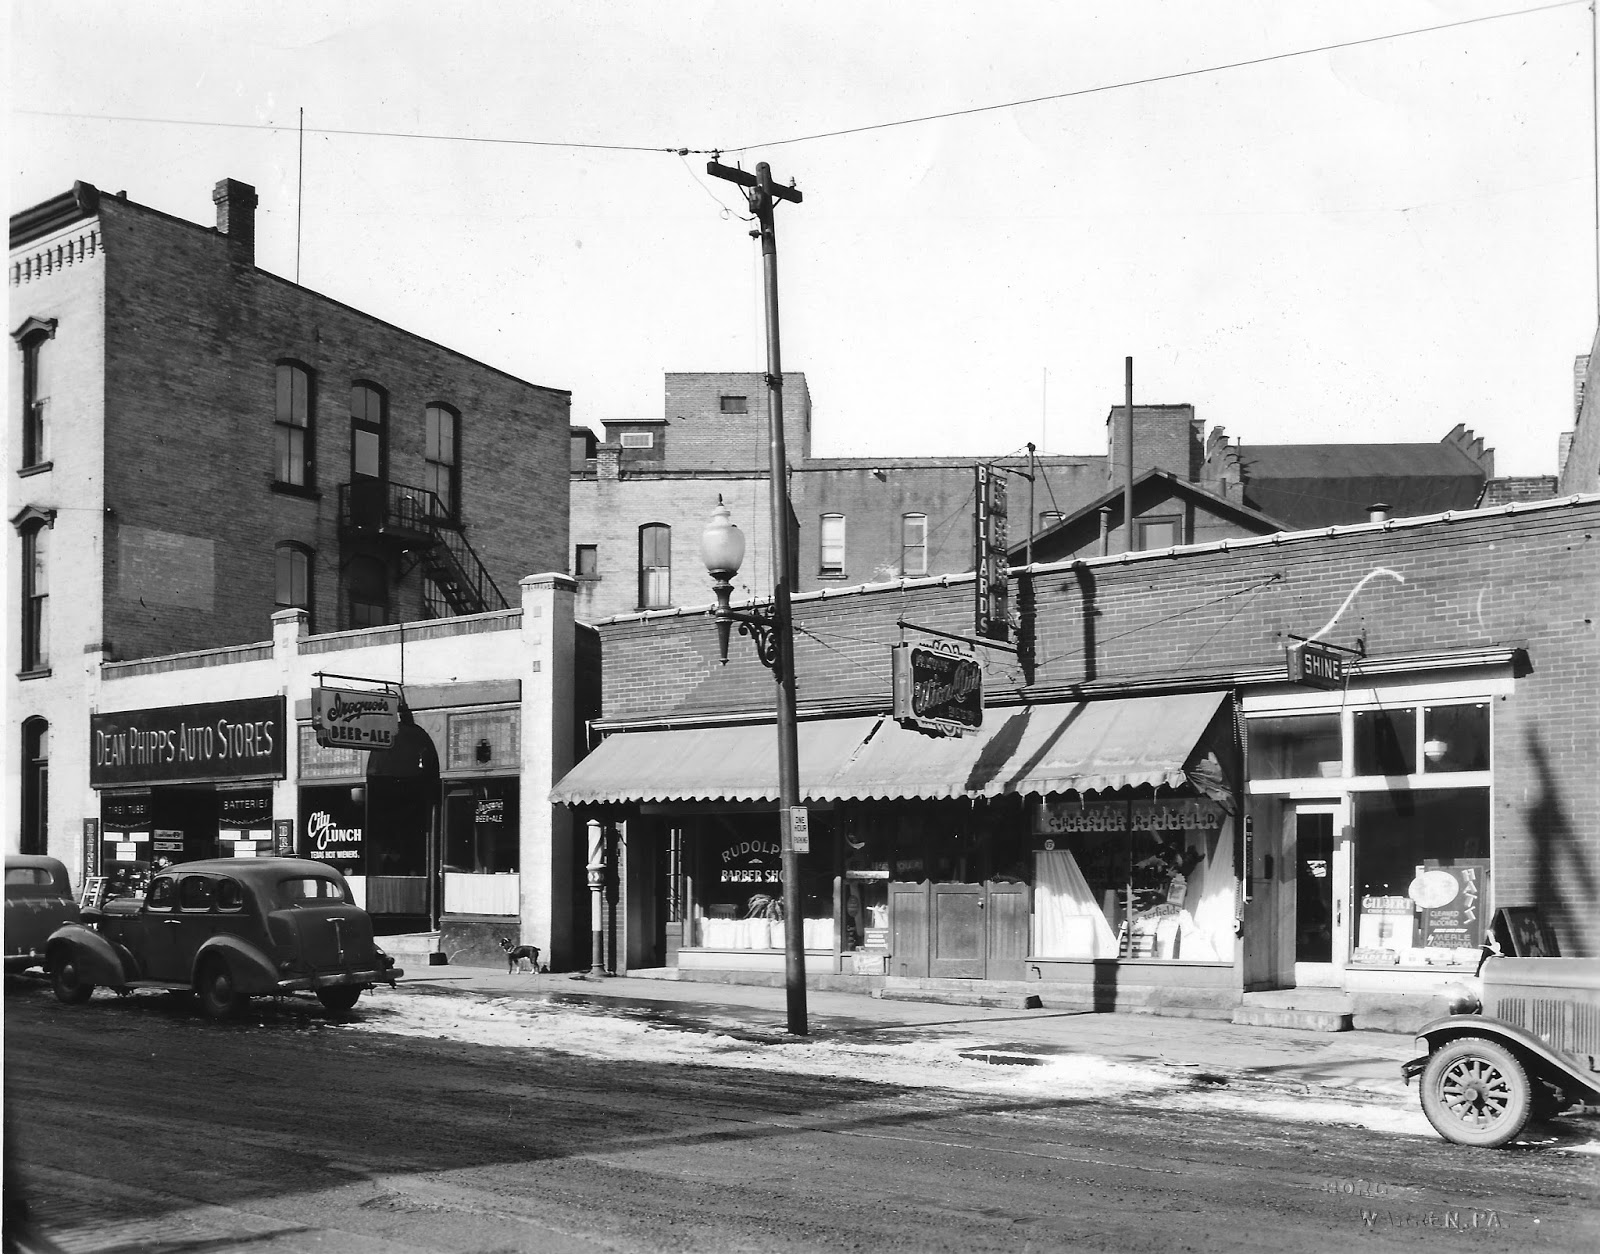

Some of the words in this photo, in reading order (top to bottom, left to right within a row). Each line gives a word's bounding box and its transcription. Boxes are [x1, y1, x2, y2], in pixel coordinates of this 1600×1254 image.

[978, 465, 989, 634] BILLIARDS
[1304, 653, 1340, 680] SHINE
[327, 692, 393, 722] Iroquois
[96, 729, 126, 766] DEAN
[130, 726, 175, 765] PHIPPS
[178, 722, 213, 762] AUTO
[217, 717, 275, 759] STORES
[331, 725, 391, 743] BEER-ALE
[308, 810, 331, 838] City
[1049, 812, 1215, 829] CHESTERFIELD
[721, 839, 782, 863] RUDOLP
[720, 869, 763, 883] BARBER
[1434, 933, 1472, 941] MERLE
